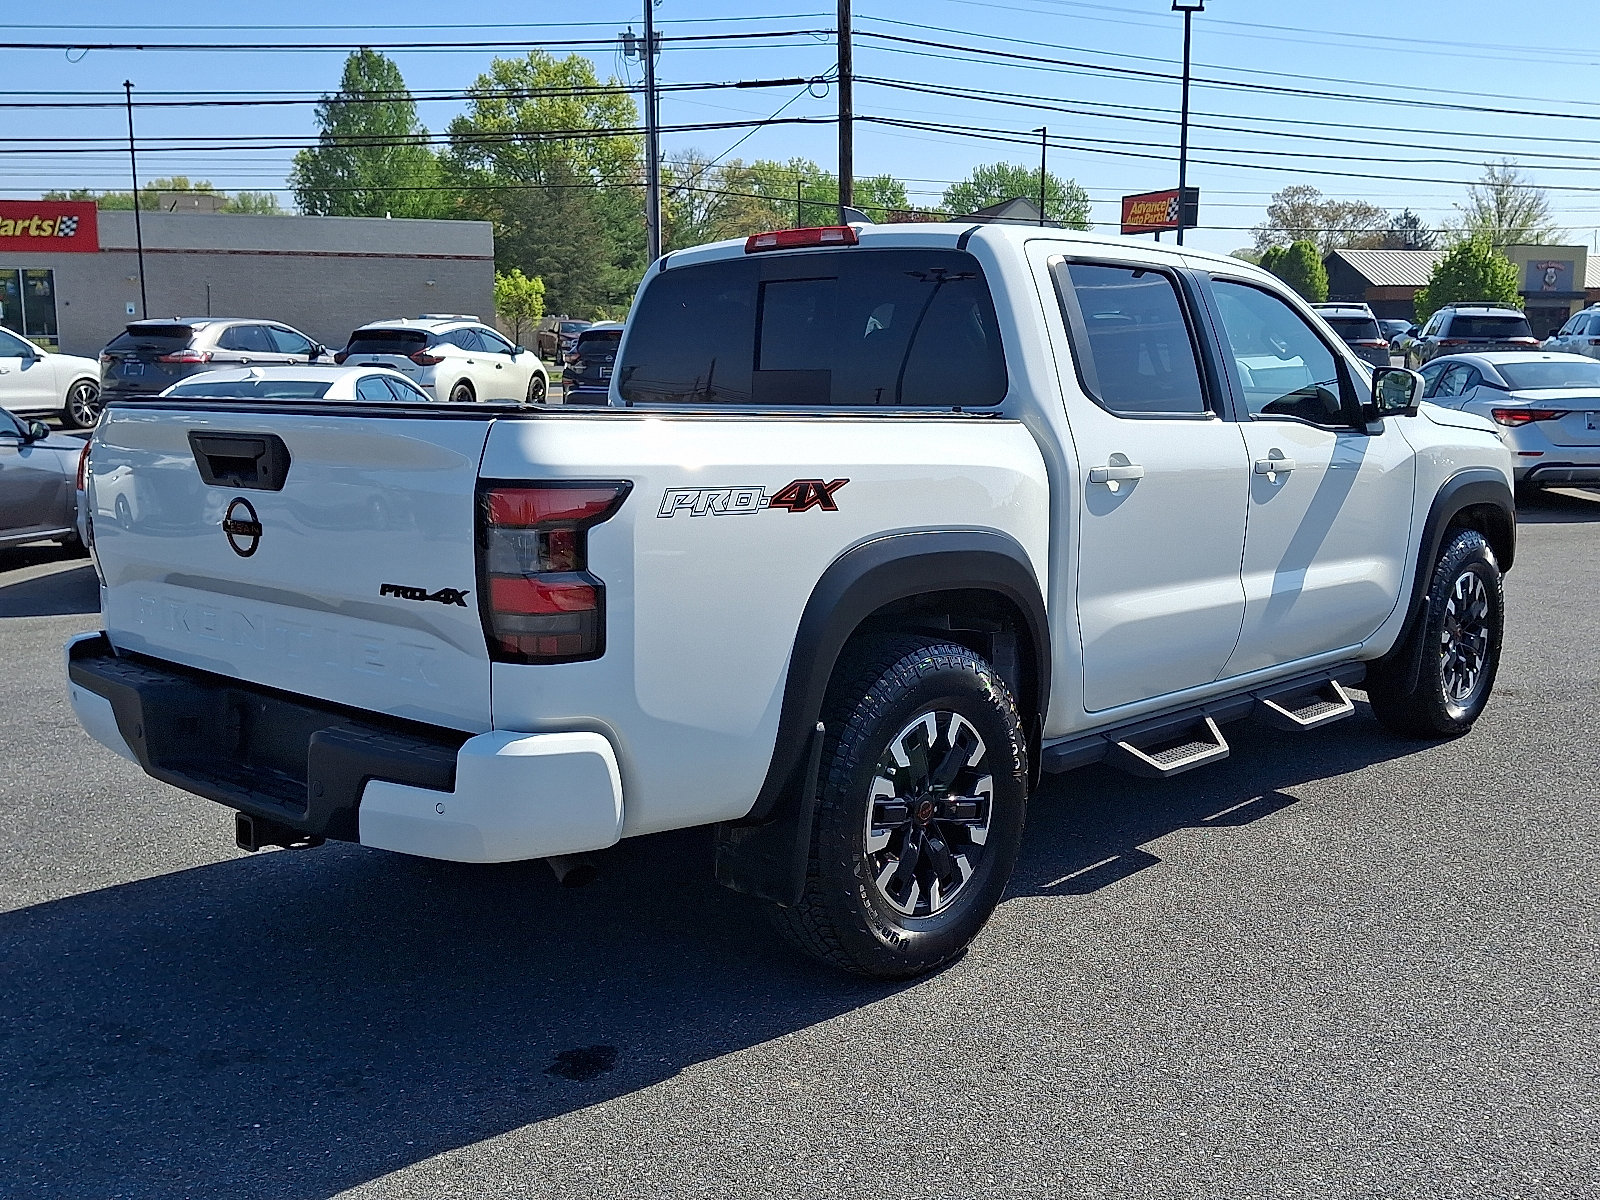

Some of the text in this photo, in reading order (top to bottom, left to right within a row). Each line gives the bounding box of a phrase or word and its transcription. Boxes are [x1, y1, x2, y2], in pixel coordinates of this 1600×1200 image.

[1130, 201, 1167, 214] Advance
[0, 214, 55, 237] arts
[1127, 212, 1164, 224] Auto Parts
[656, 478, 850, 518] PRO-4X
